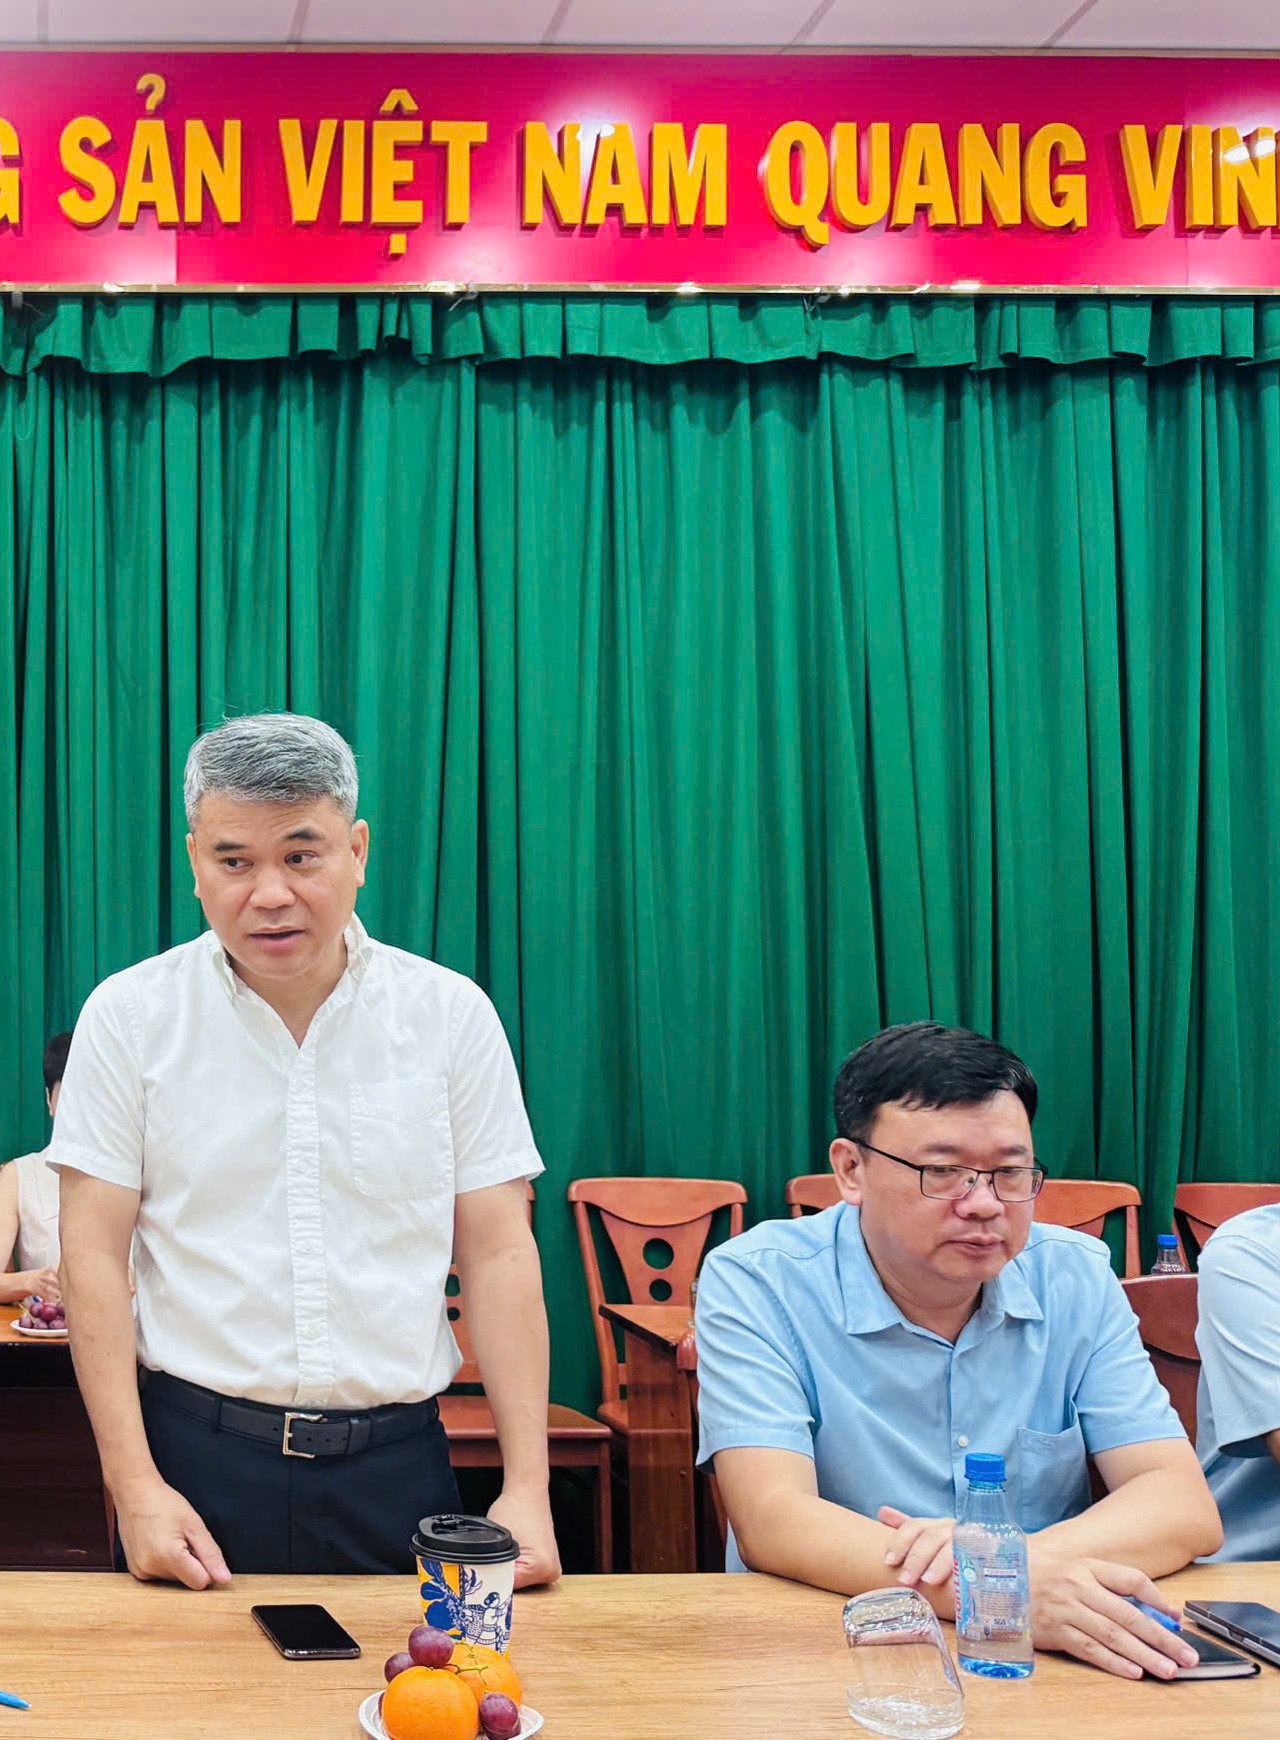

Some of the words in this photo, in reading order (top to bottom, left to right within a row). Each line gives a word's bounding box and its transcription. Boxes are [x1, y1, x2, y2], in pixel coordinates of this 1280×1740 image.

[57, 73, 241, 227] SẢN
[278, 88, 487, 257] VIỆT
[521, 121, 727, 229] NAM
[761, 121, 1087, 250] QUANG
[1120, 124, 1280, 229] VIN
